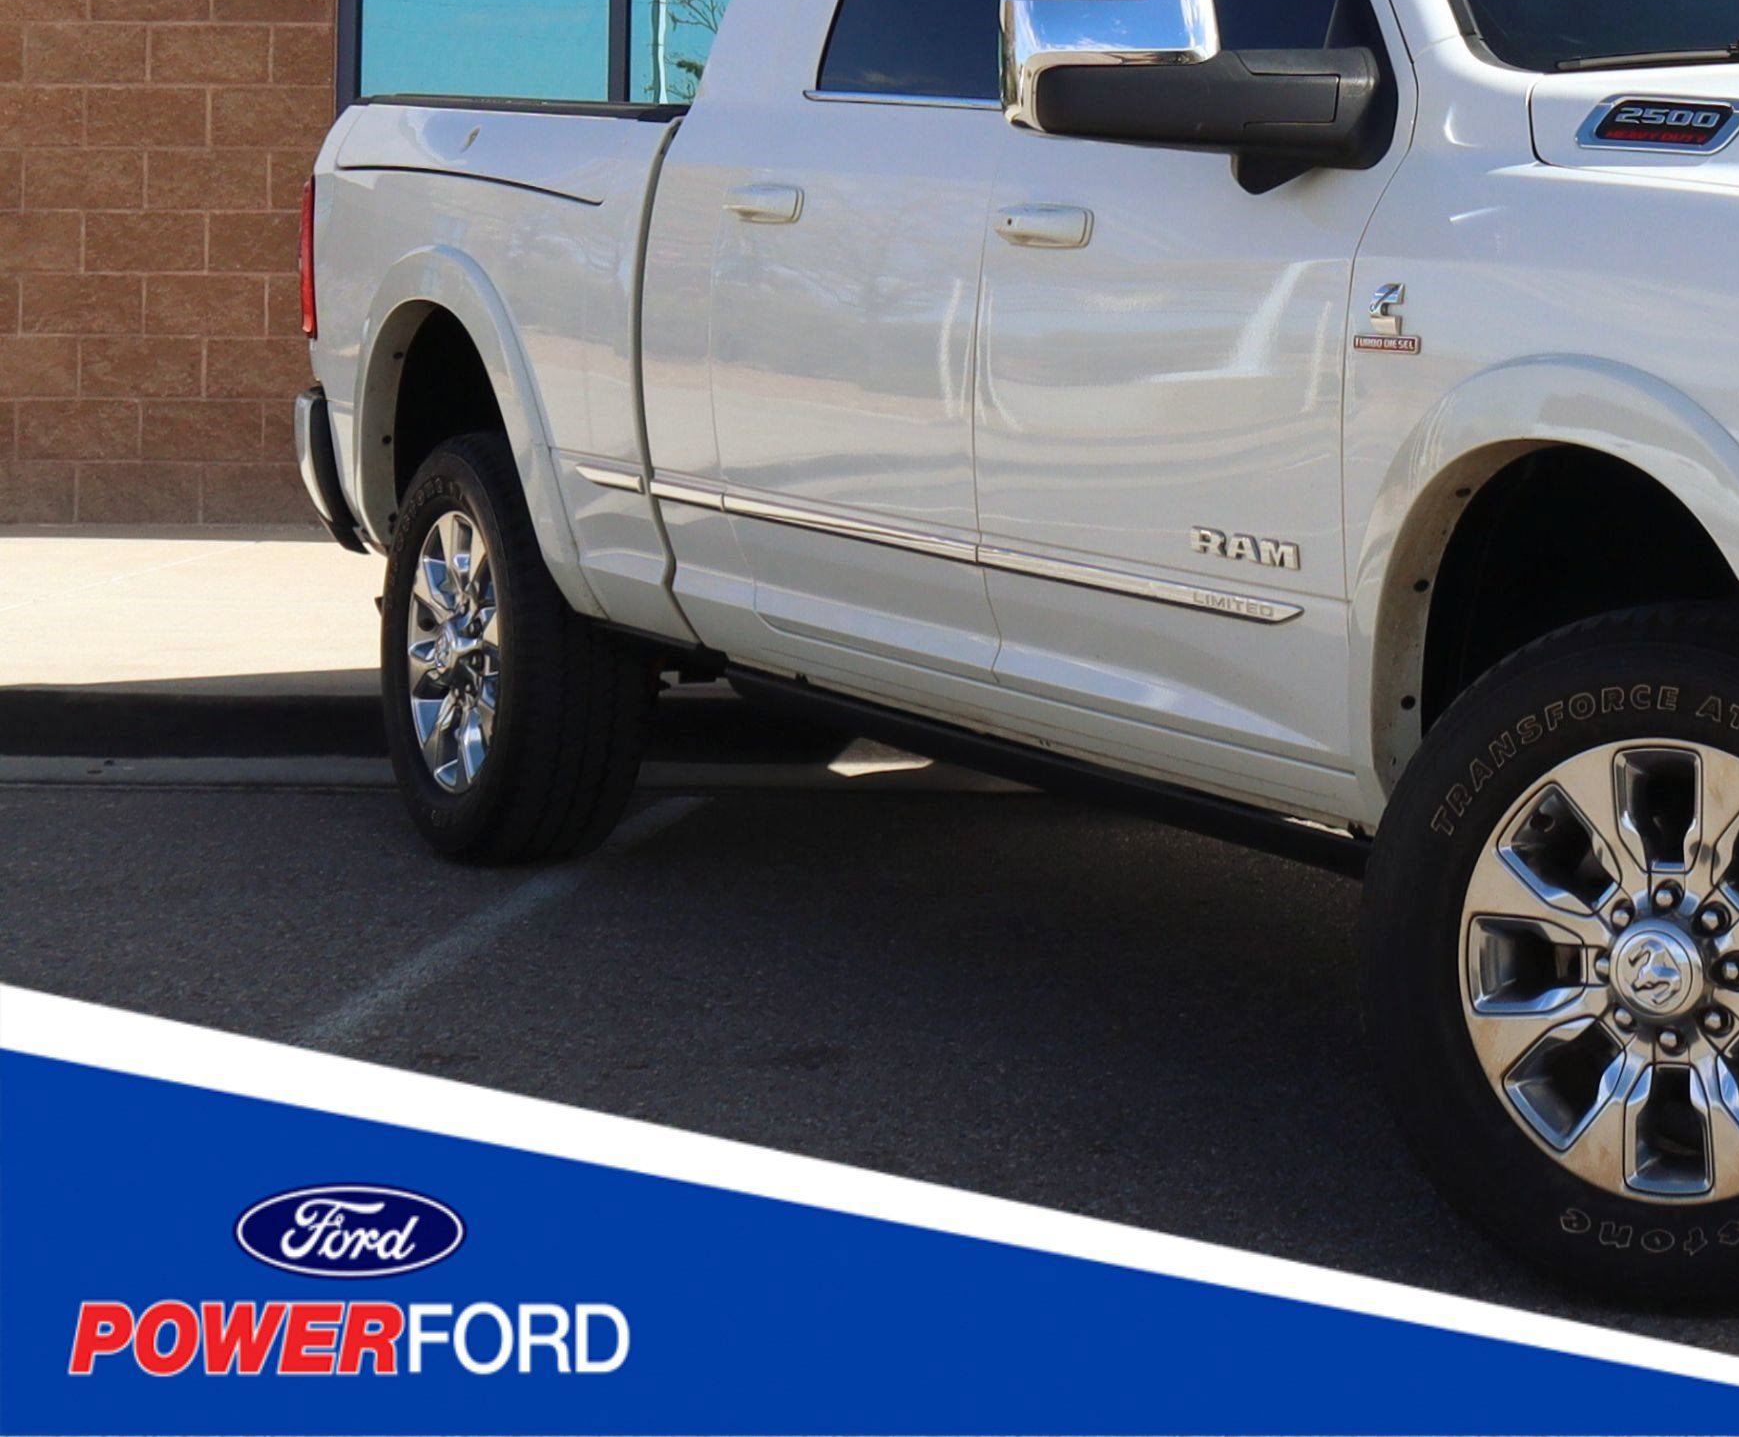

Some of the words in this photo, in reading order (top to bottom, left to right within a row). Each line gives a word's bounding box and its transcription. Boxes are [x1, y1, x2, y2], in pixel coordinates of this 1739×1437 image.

[1614, 107, 1722, 129] 2500
[1659, 131, 1708, 143] DUTY
[1384, 338, 1415, 350] DIESEL
[1190, 525, 1301, 571] RAM
[1193, 591, 1275, 618] LIMITED
[1429, 683, 1680, 836] TRANSFORCE
